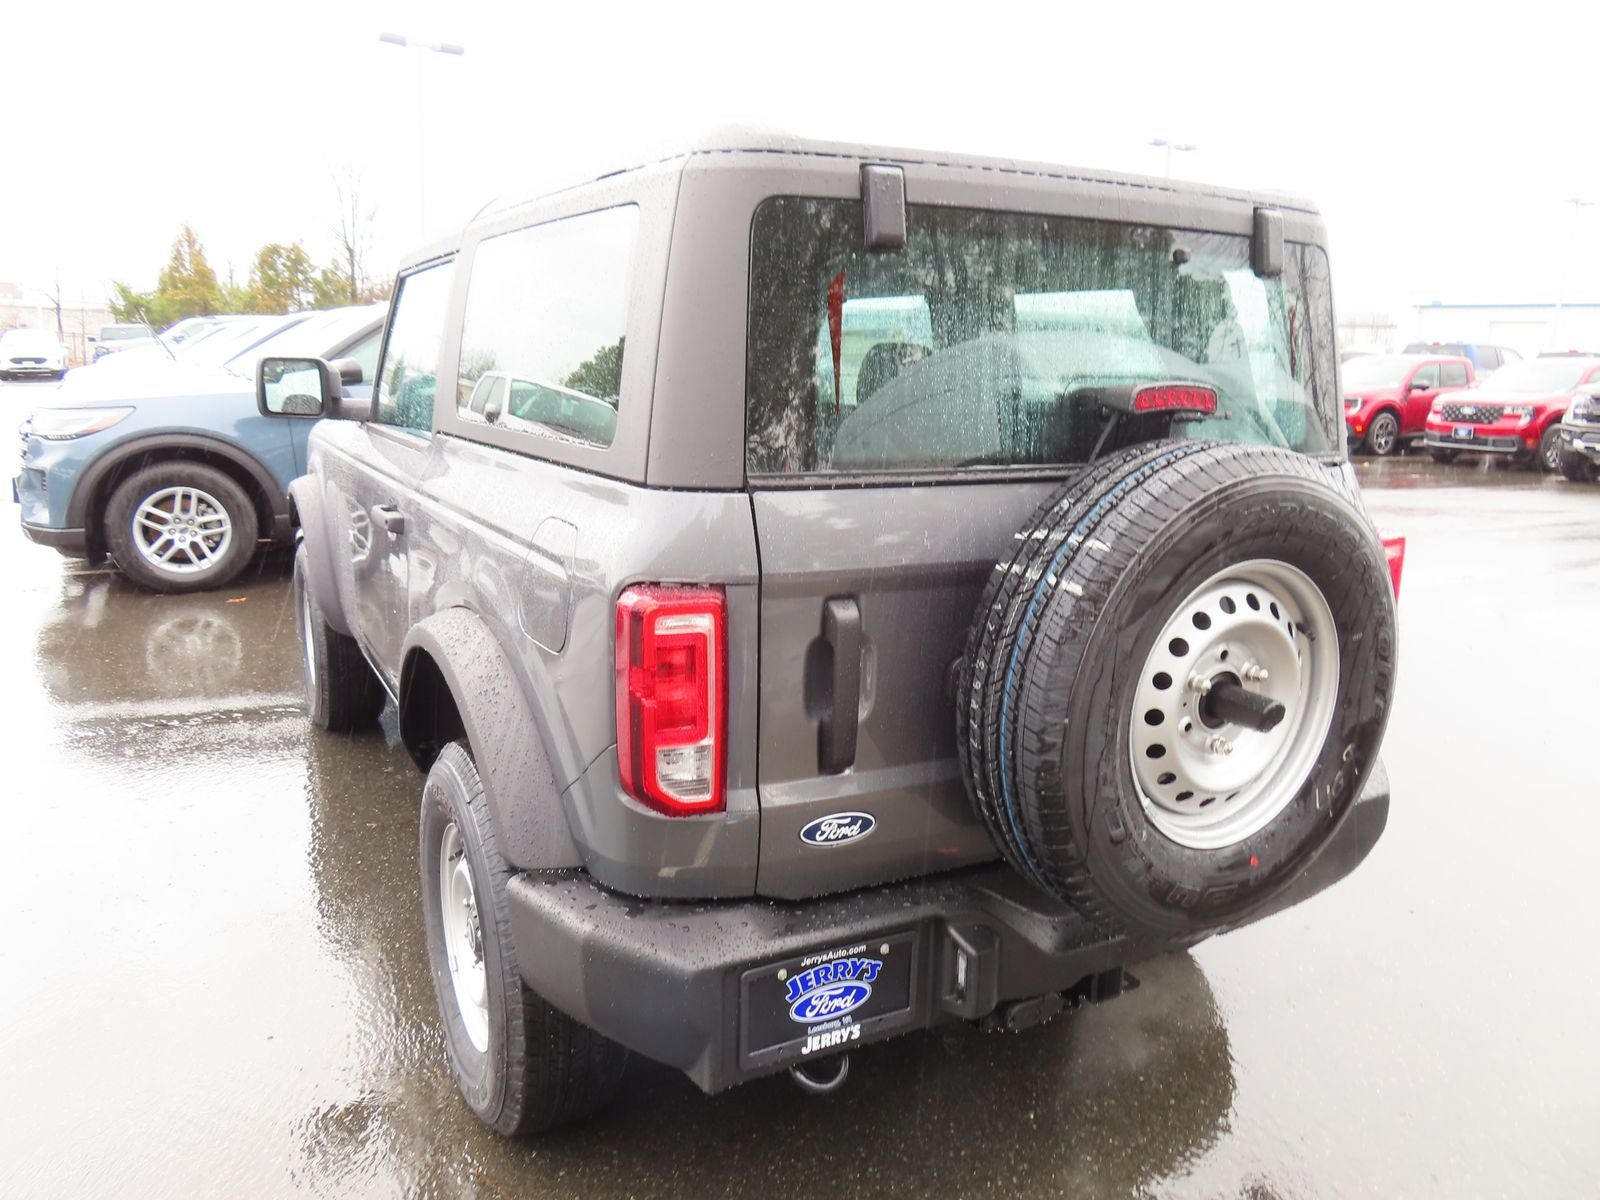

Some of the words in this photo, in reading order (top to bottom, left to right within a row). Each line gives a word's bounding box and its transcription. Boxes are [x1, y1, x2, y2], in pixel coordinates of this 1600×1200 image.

[815, 817, 863, 842] Ford
[801, 945, 867, 967] JerrysAuto.com
[785, 957, 883, 1003] JERRY'S
[805, 988, 856, 1018] Ford
[801, 1023, 861, 1055] JERRY'S
